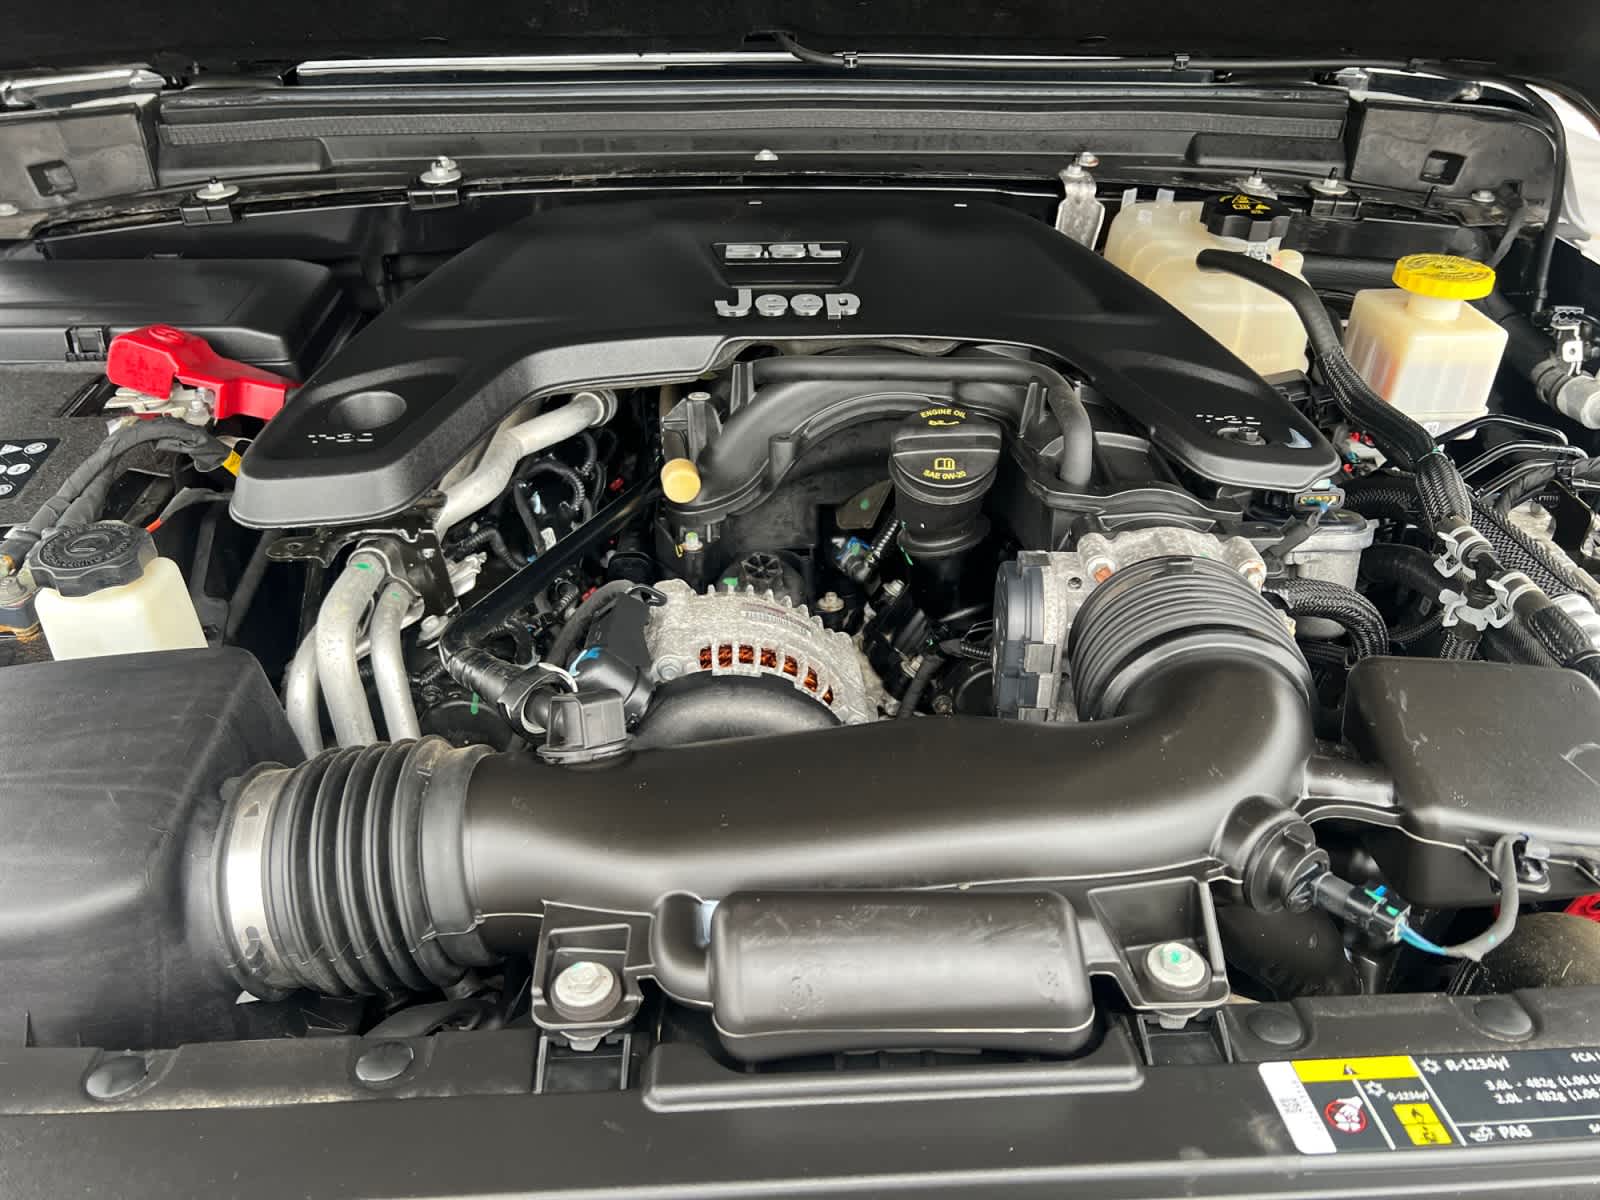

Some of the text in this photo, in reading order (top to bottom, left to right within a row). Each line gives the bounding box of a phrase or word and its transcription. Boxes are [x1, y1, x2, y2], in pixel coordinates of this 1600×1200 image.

[714, 287, 861, 320] Jeep
[920, 408, 967, 420] ENGINE OIL
[923, 469, 967, 480] SAE 0W-20
[1444, 1054, 1510, 1072] R-1234yf
[1497, 1124, 1534, 1139] PAG
